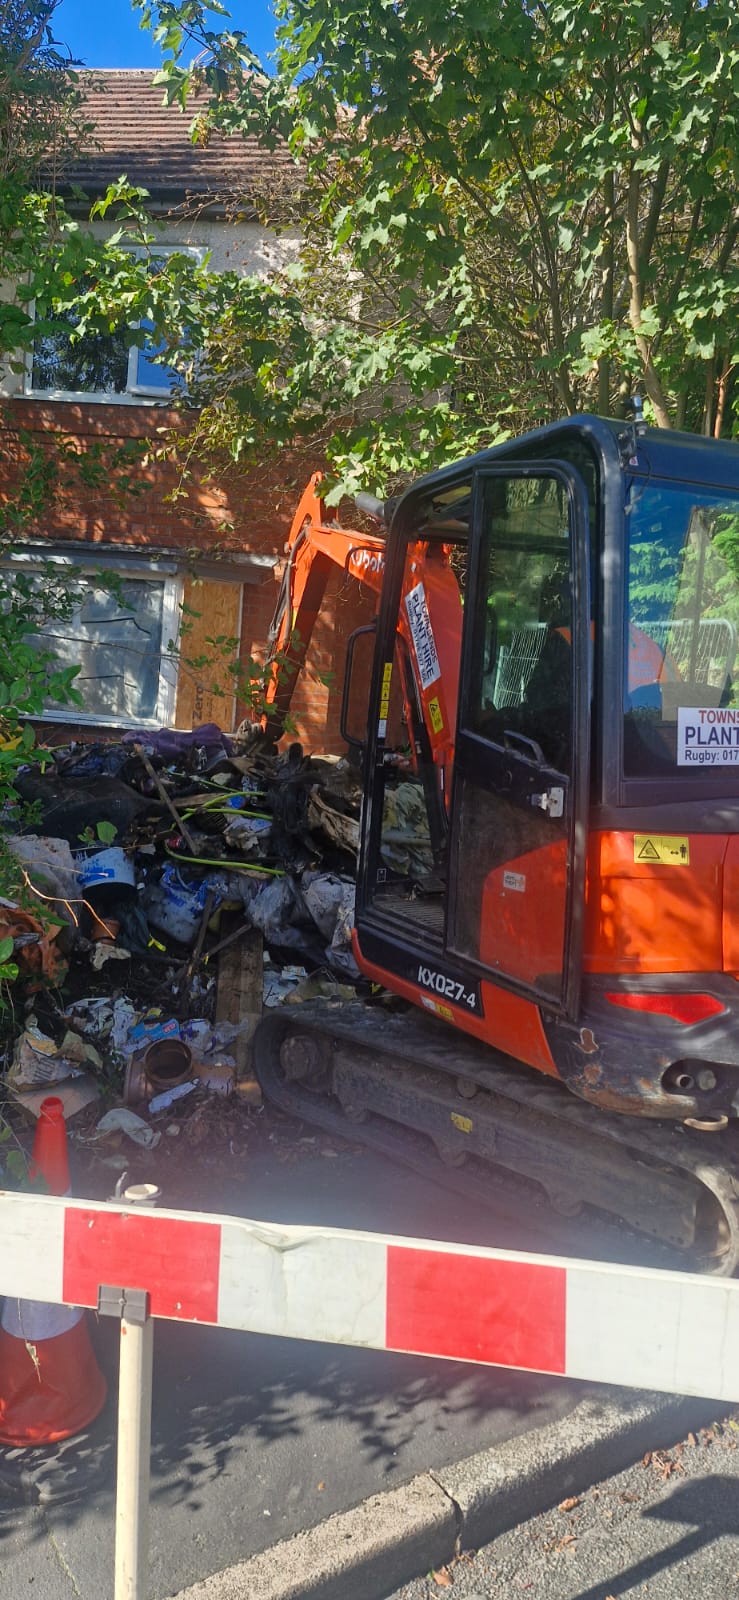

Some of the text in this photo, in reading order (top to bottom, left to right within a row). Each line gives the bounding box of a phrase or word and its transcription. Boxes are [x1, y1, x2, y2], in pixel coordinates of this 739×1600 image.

[349, 543, 386, 573] Kubot
[412, 593, 427, 639] PLANT
[421, 642, 435, 678] HIRE
[684, 749, 720, 763] Rugby:
[417, 965, 477, 1008] KX027-4
